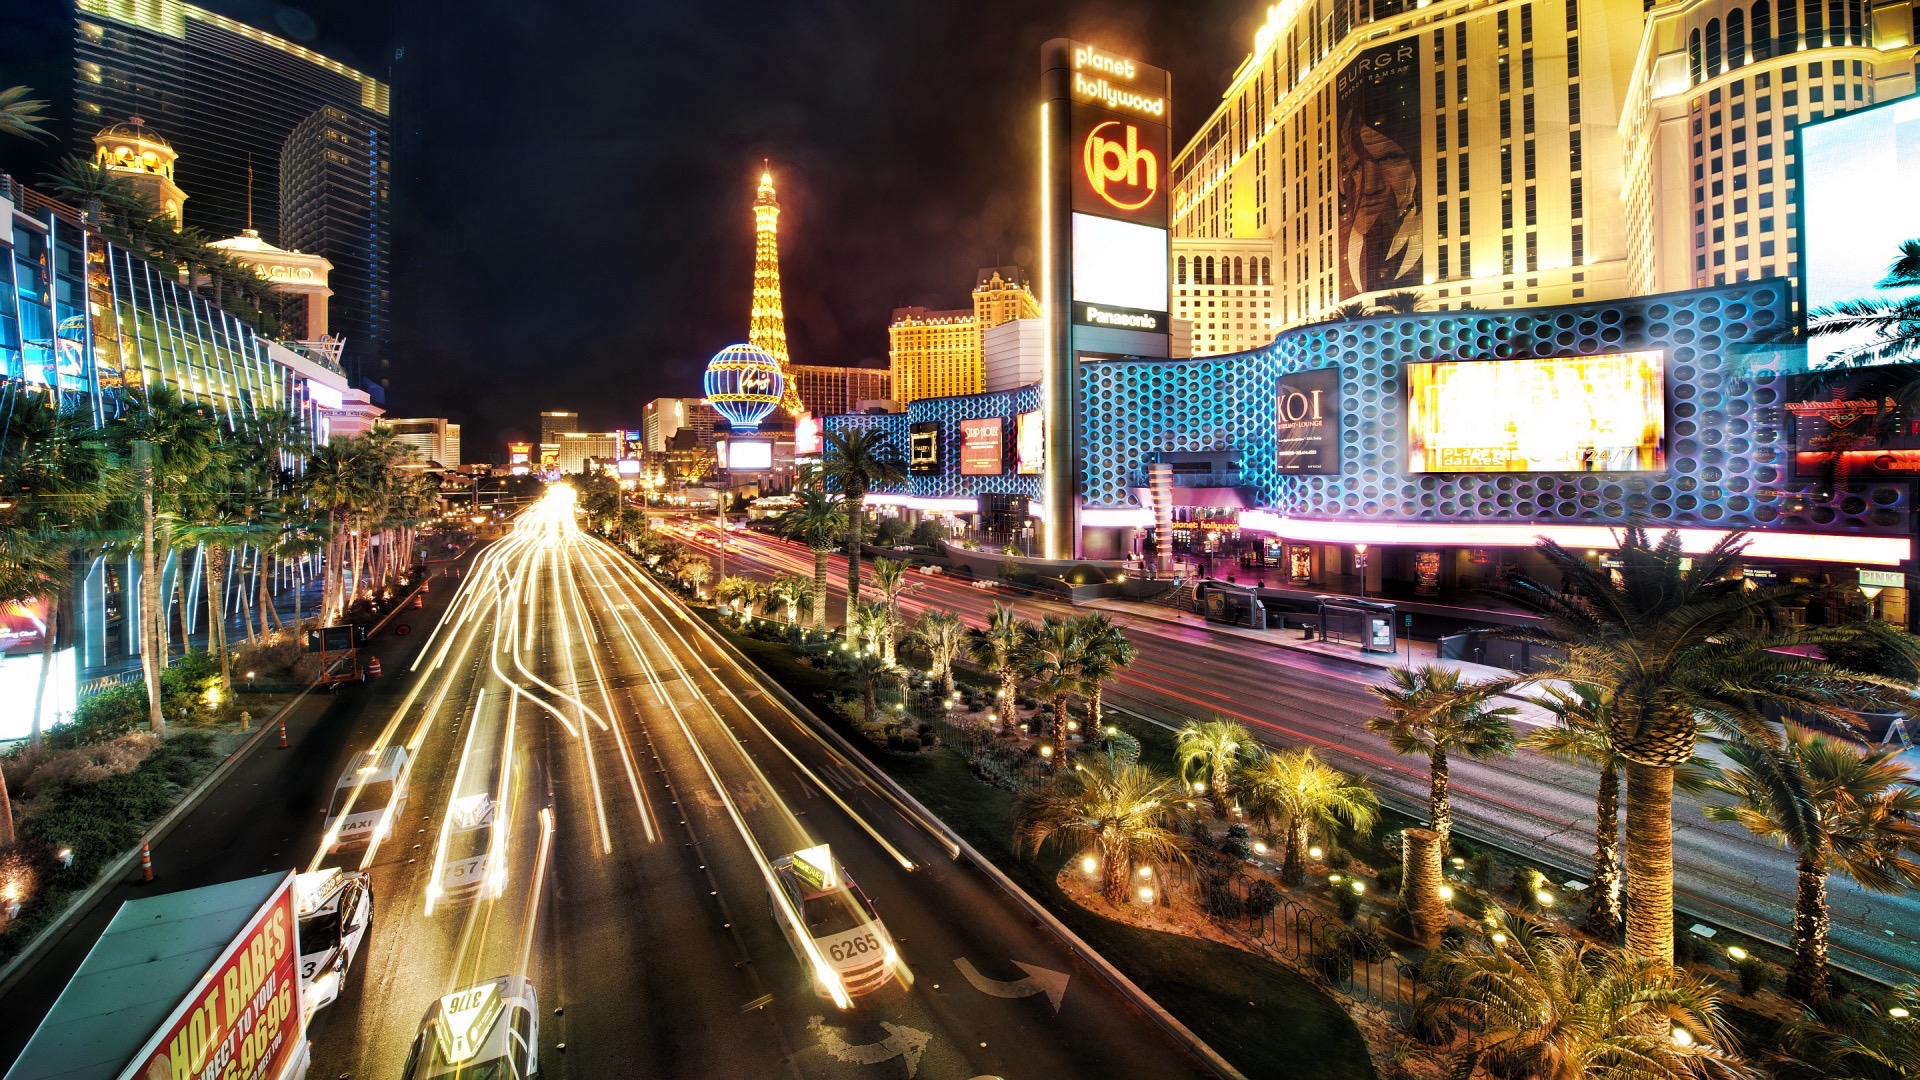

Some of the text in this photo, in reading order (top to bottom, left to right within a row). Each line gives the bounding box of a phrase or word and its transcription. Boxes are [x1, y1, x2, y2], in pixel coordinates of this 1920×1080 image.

[1075, 46, 1135, 79] planet
[1338, 47, 1413, 92] BURGR
[1368, 65, 1409, 80] RAMSAY
[1075, 72, 1163, 116] hollywood
[1093, 125, 1157, 195] ph
[255, 264, 314, 280] AGIO
[1086, 306, 1156, 329] Panasonic
[739, 363, 770, 396] Paris
[1277, 389, 1323, 423] KOI
[1298, 420, 1322, 428] LOUNGE
[1172, 521, 1239, 531] planet hollywoo
[342, 820, 372, 831] TAXI
[829, 933, 880, 962] 6265
[170, 906, 286, 1080] HOT BABES
[449, 991, 482, 1015] 3776
[198, 1027, 237, 1080] IRECT
[237, 1007, 252, 1042] TO
[252, 970, 277, 1019] YOU!
[257, 1030, 282, 1077] MEET YOU
